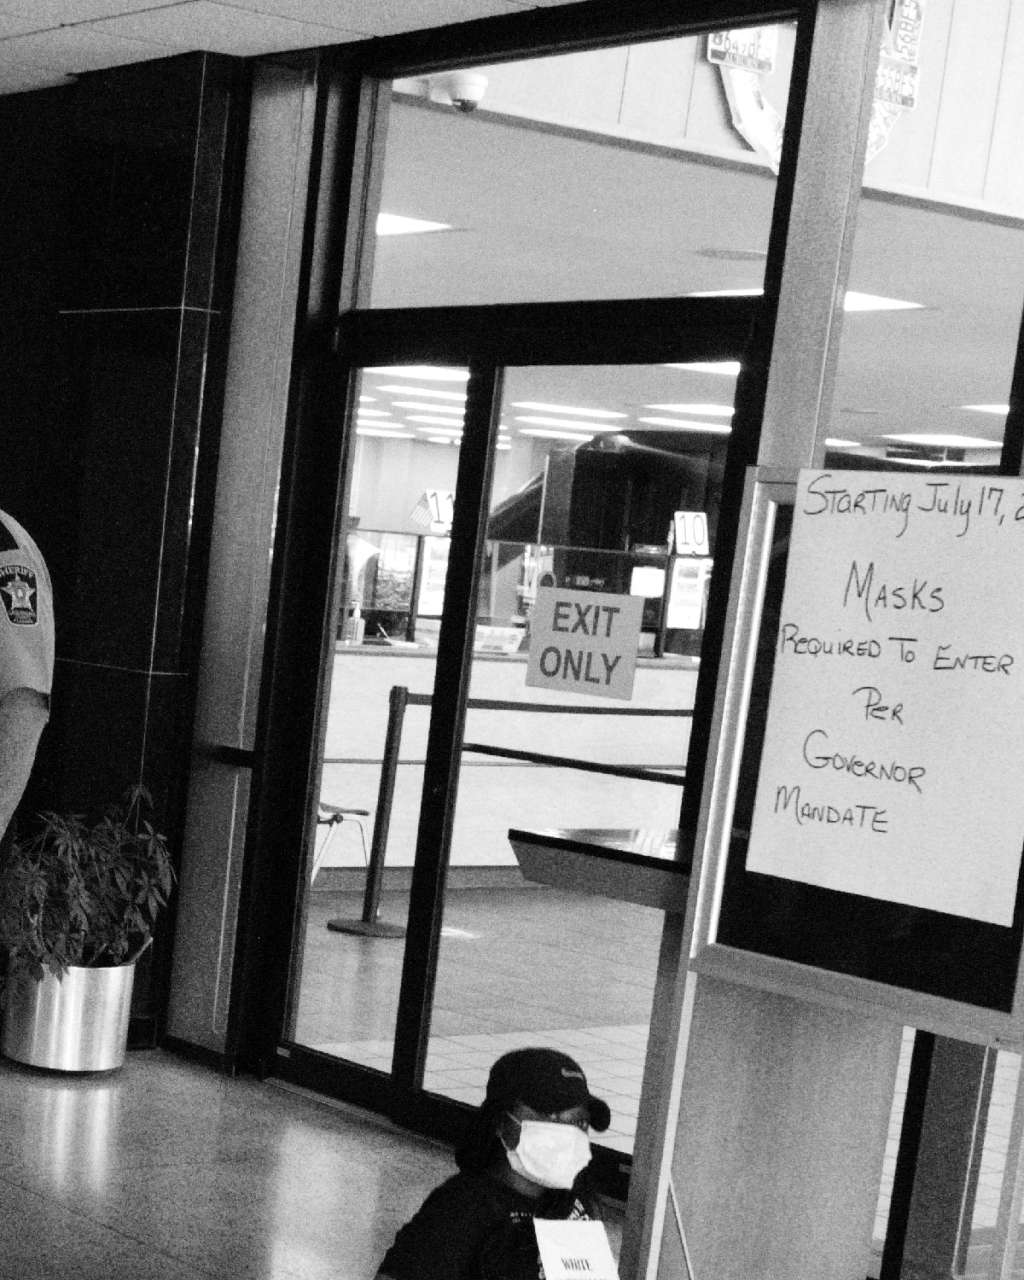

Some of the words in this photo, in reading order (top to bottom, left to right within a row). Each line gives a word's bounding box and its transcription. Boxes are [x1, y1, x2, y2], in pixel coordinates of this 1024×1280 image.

[917, 482, 972, 538] July
[978, 485, 1005, 526] 17,
[679, 514, 704, 546] 10
[843, 560, 945, 622] MASKS
[552, 601, 621, 638] EXIT
[539, 646, 622, 686] ONLY
[933, 644, 1014, 676] ENTER
[561, 1258, 592, 1271] WHITE
